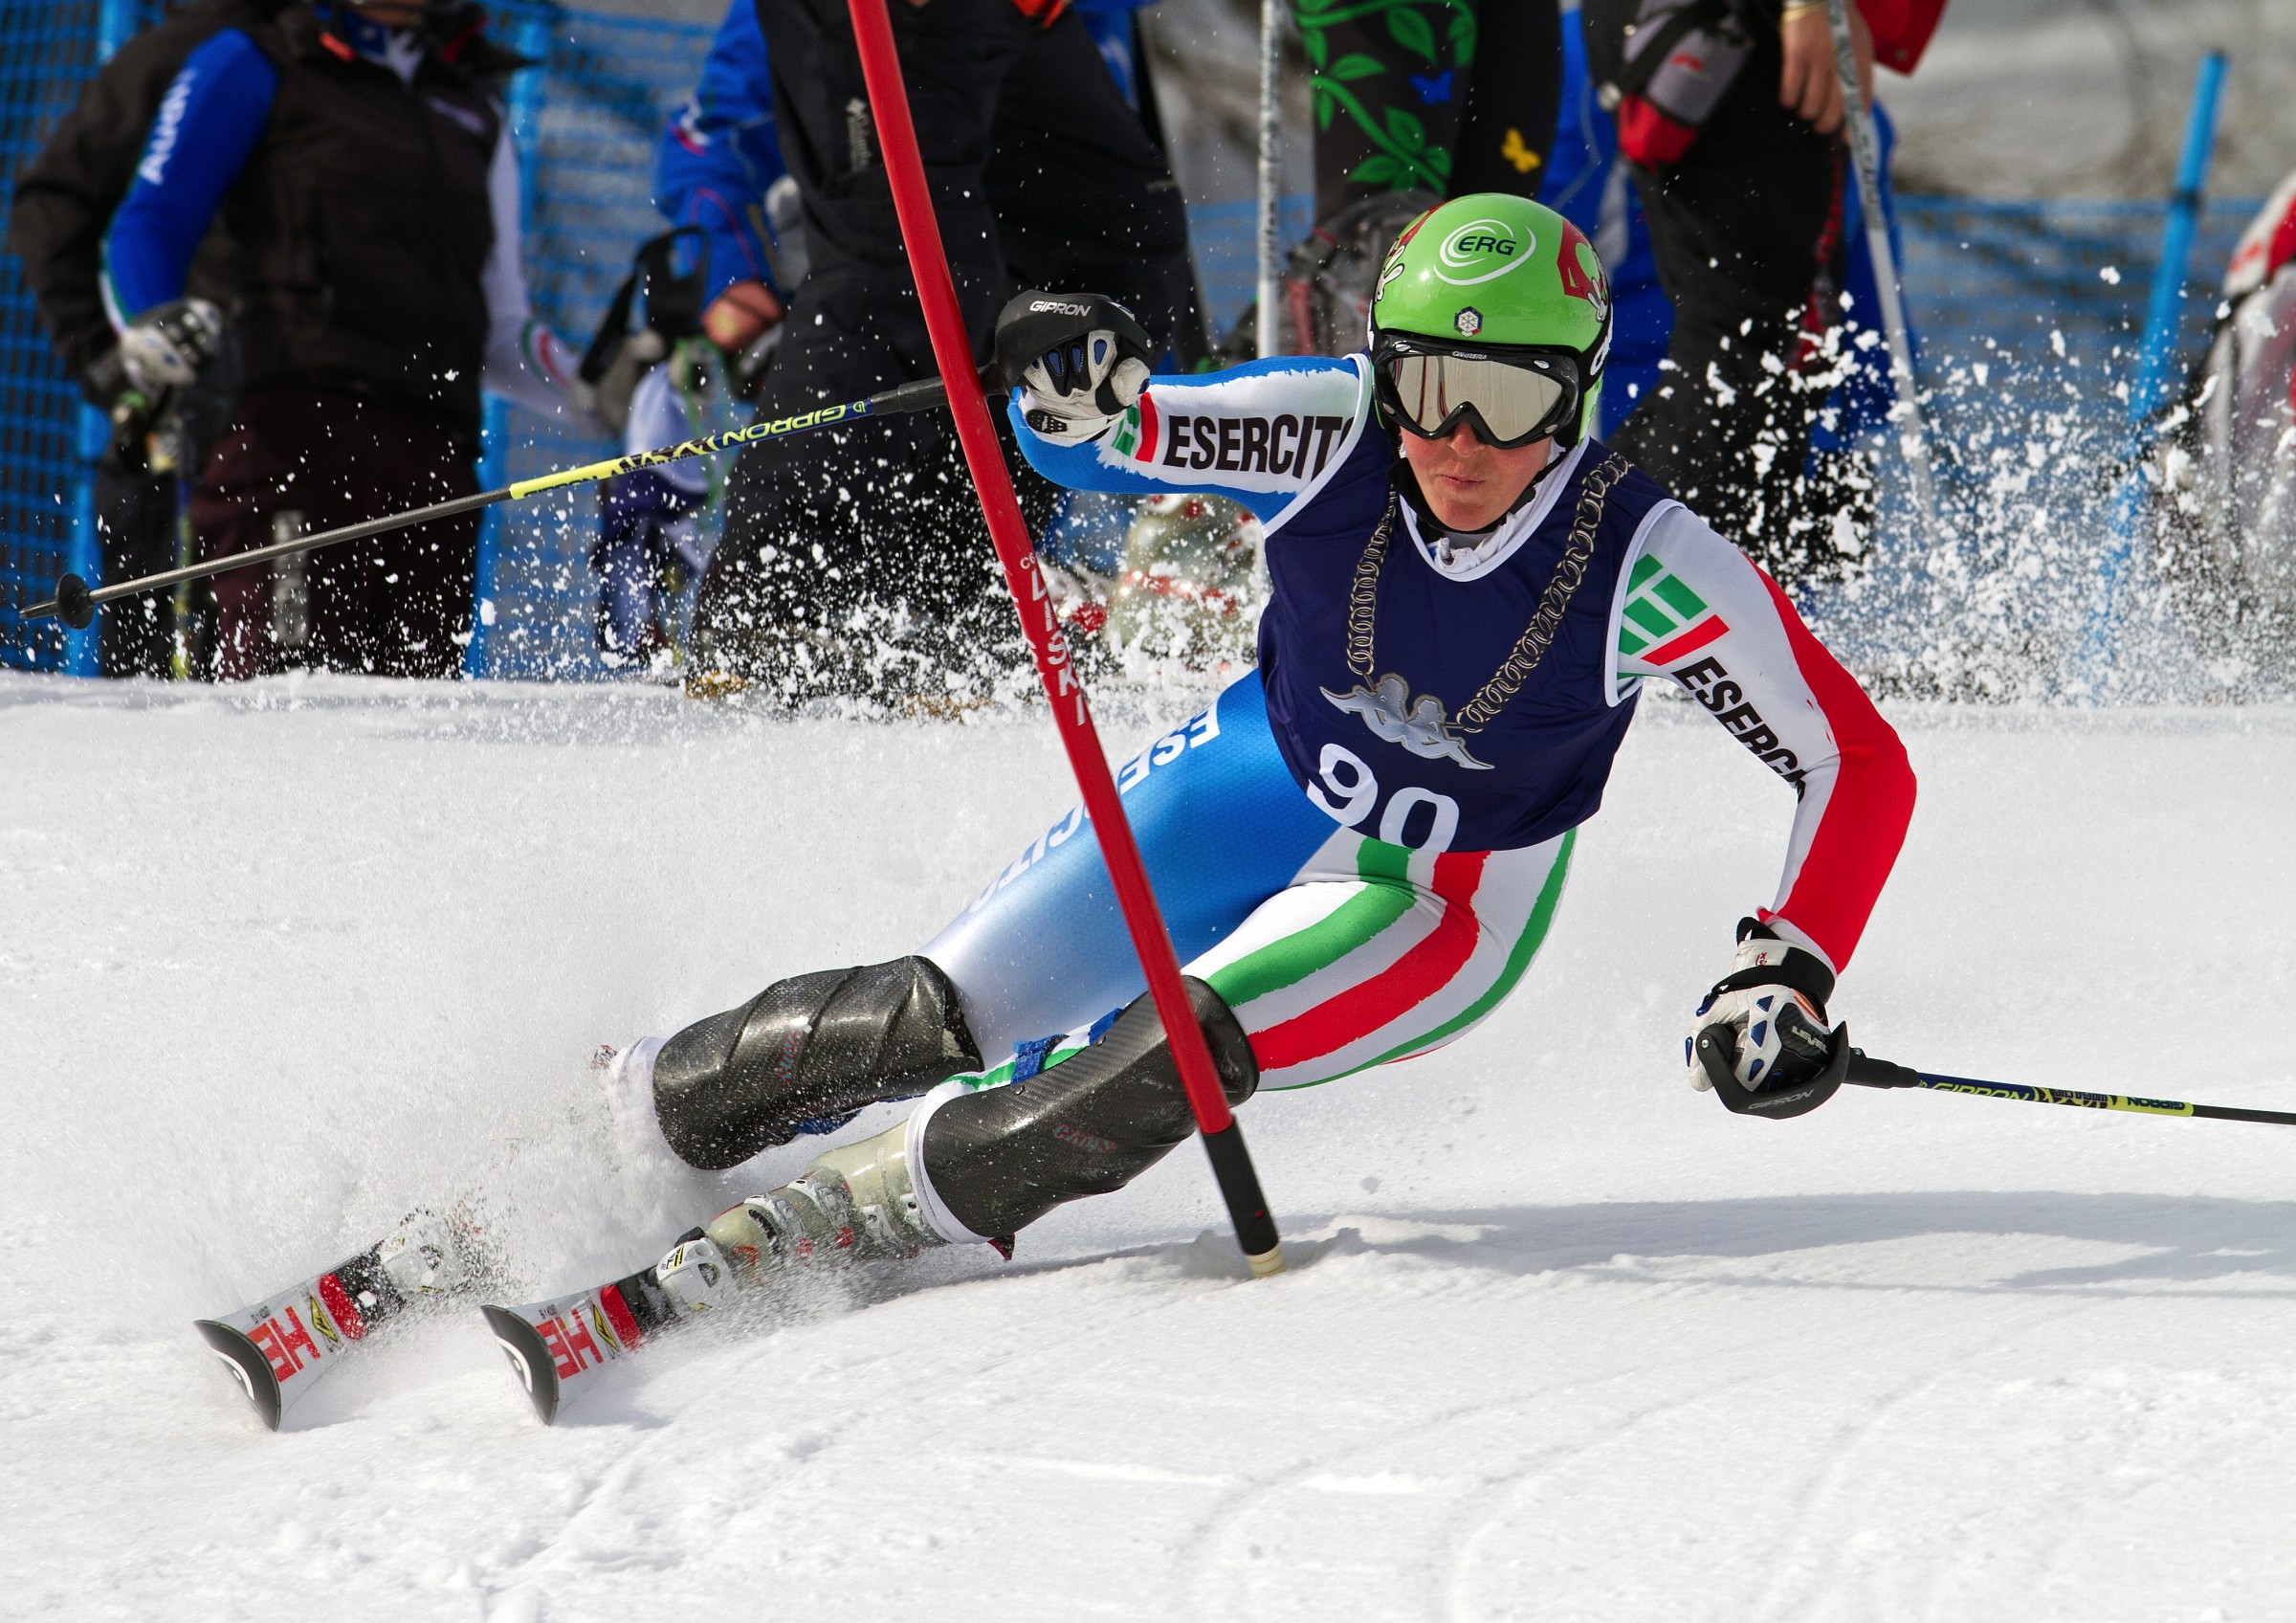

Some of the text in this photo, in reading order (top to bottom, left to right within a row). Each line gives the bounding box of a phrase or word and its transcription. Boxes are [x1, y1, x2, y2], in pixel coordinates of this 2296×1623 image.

[1458, 235, 1517, 256] ERG
[1028, 300, 1092, 318] GIPRON
[722, 404, 847, 447] GIPRON
[1031, 567, 1086, 727] LISKI
[1306, 743, 1460, 854] 90
[1791, 1025, 1829, 1055] LEVEL
[1748, 1088, 1816, 1110] GIPRON
[2126, 1096, 2186, 1111] GIPRON
